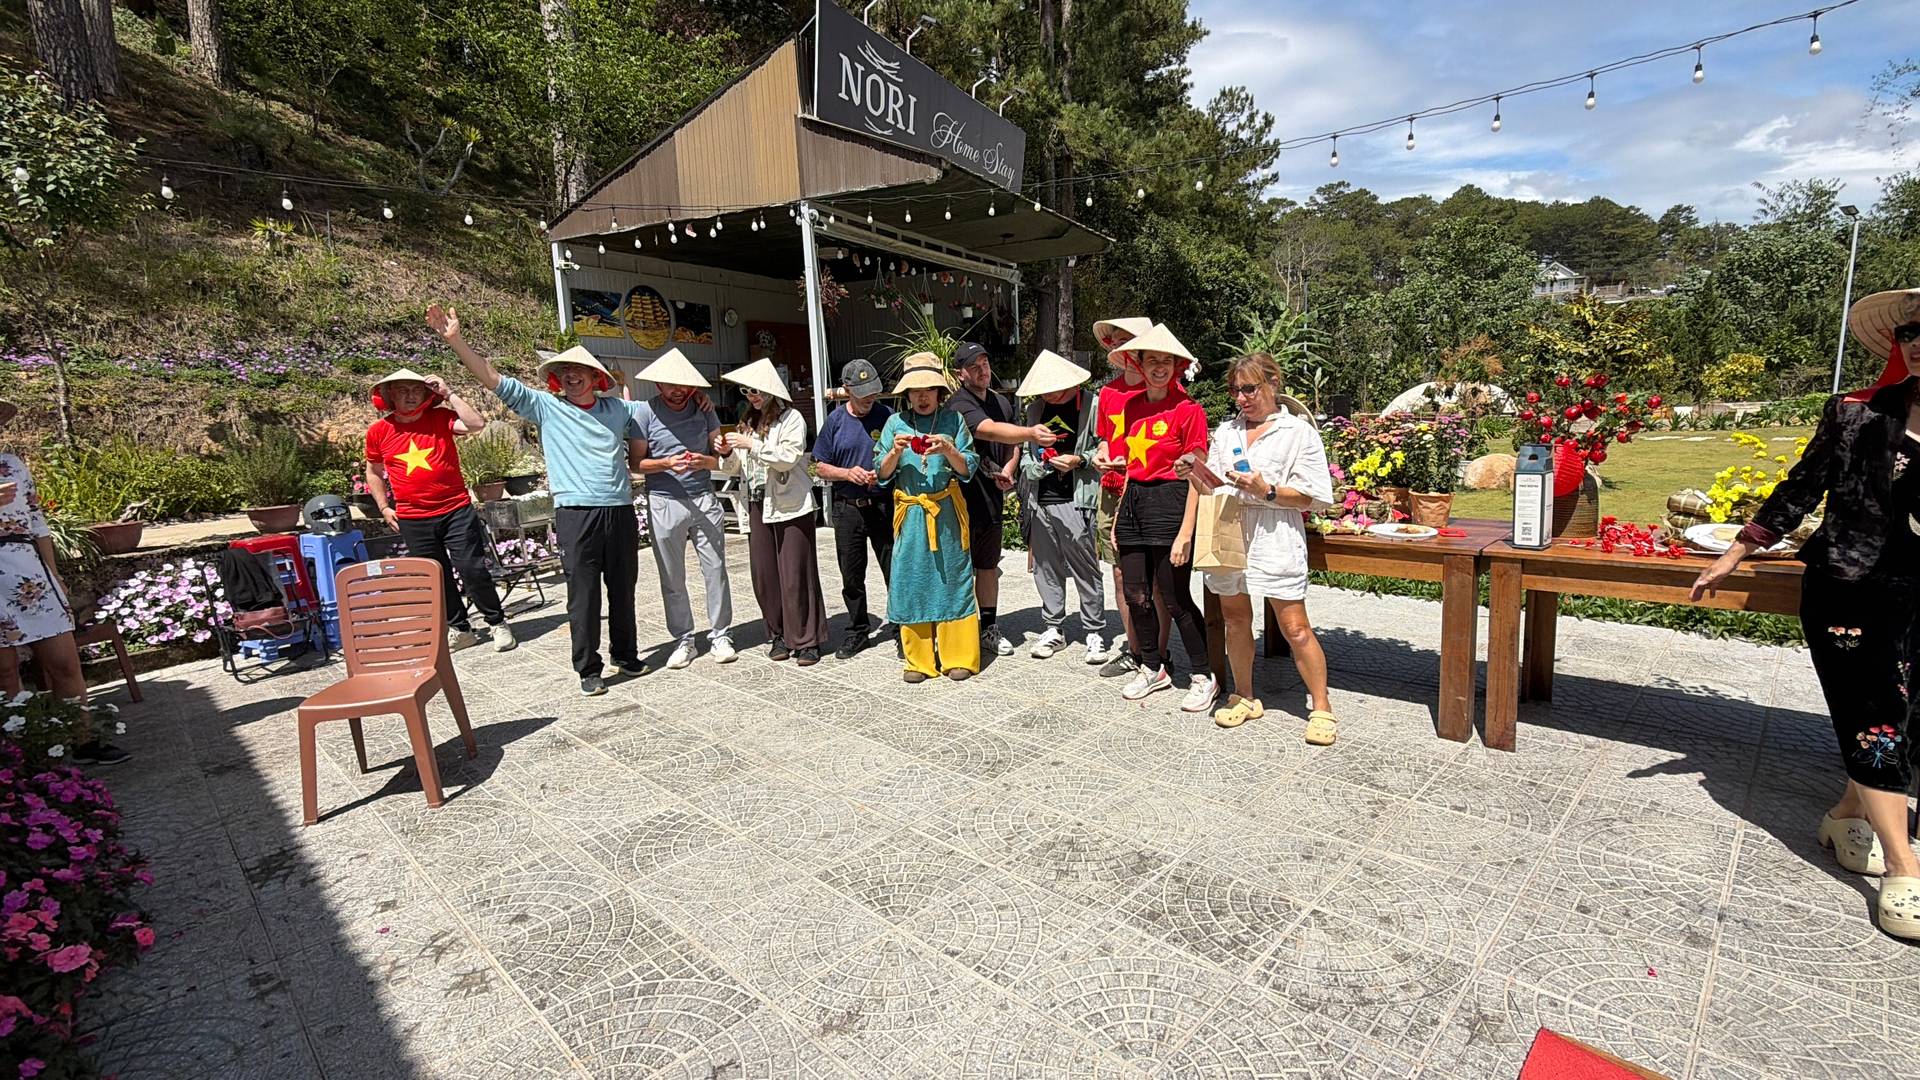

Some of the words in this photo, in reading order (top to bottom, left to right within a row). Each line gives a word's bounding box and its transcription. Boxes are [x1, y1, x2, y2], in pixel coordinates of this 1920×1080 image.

[838, 52, 917, 135] NORI
[930, 112, 980, 163] Home
[983, 143, 1015, 188] Stay
